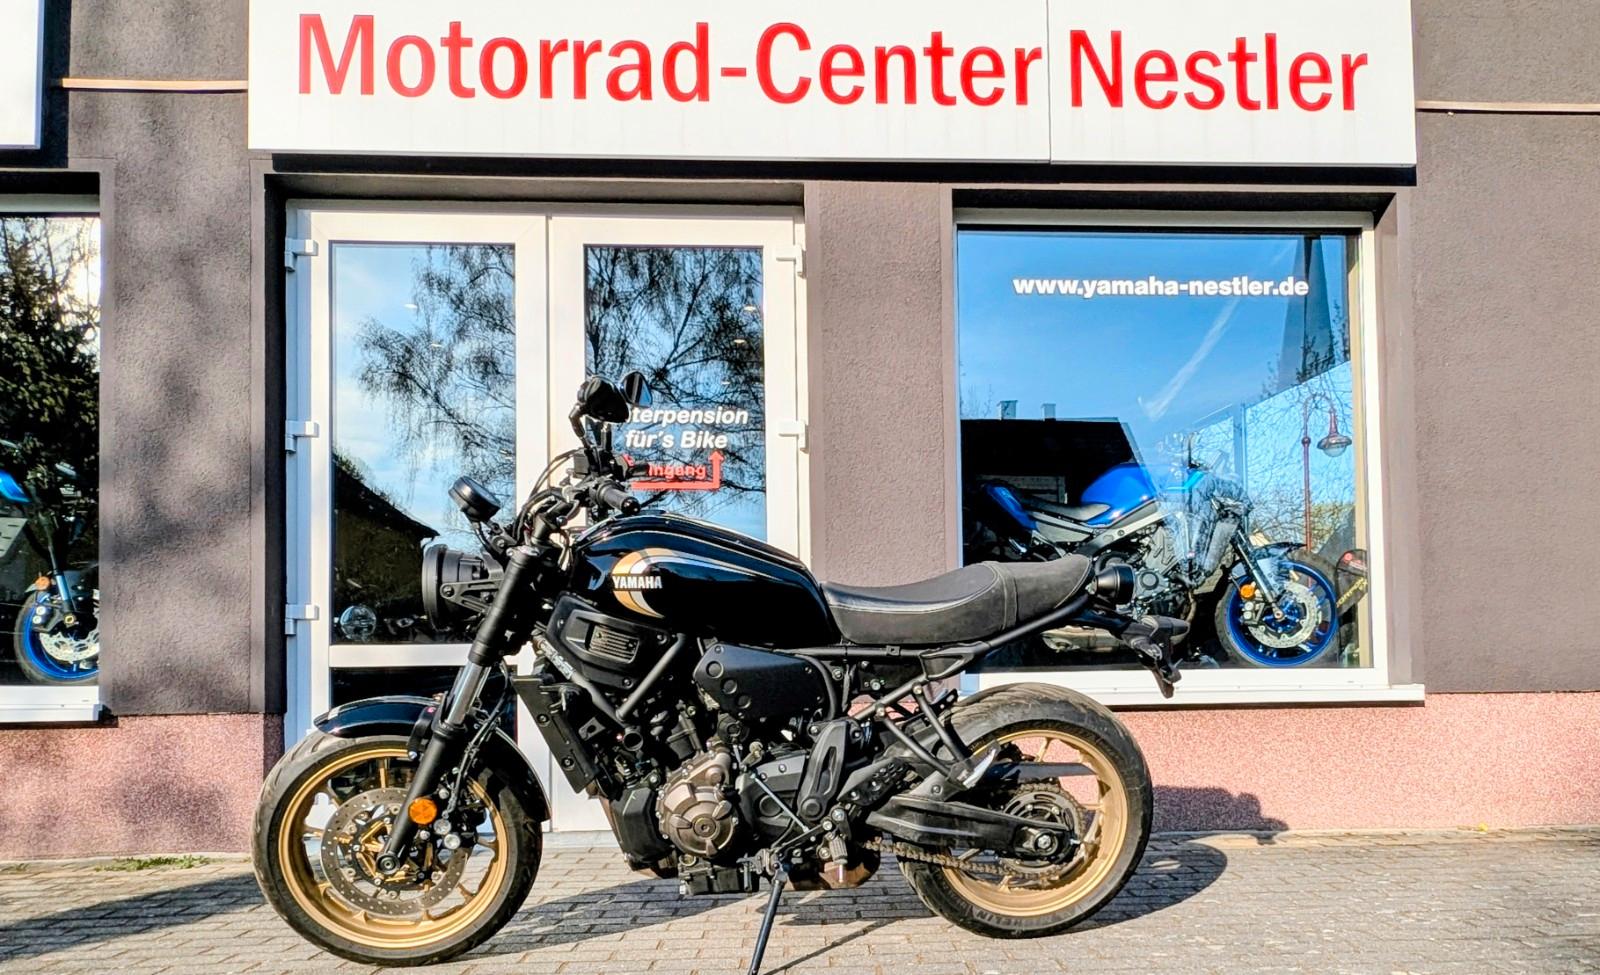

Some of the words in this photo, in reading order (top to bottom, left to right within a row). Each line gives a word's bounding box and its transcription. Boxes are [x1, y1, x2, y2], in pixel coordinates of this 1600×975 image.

[299, 14, 1043, 107] Motorrad-Center
[1069, 29, 1369, 113] Nestler
[1012, 276, 1310, 298] www.yamaha-nestler.de
[626, 407, 749, 426] terpension
[680, 430, 728, 448] Bike
[648, 463, 707, 479] ingang
[611, 575, 663, 589] YAMAHA
